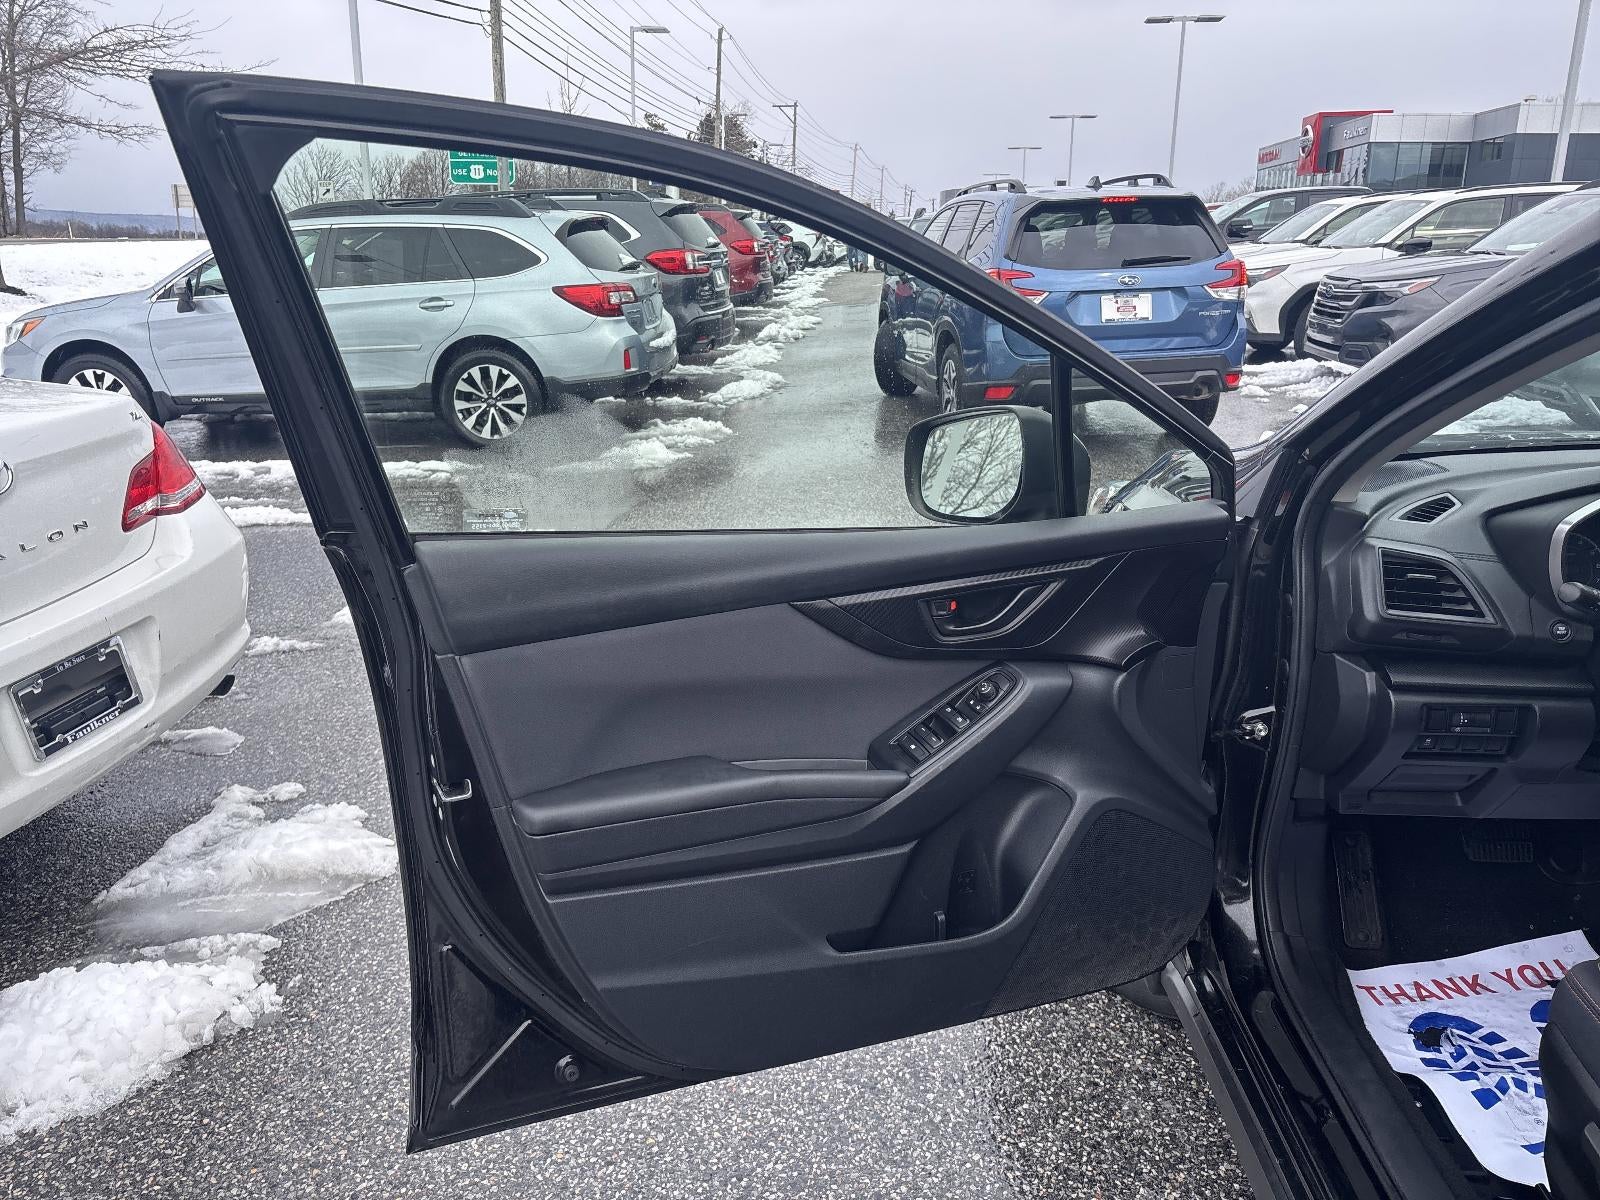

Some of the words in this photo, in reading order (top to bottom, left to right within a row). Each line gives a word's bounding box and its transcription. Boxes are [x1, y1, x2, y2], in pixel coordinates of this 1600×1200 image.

[473, 167, 480, 177] 11
[56, 663, 64, 672] To
[64, 660, 72, 668] Be
[72, 655, 86, 666] Sure
[66, 708, 121, 744] Faulkner
[1356, 974, 1498, 1006] THANK
[1489, 958, 1570, 991] YOU
